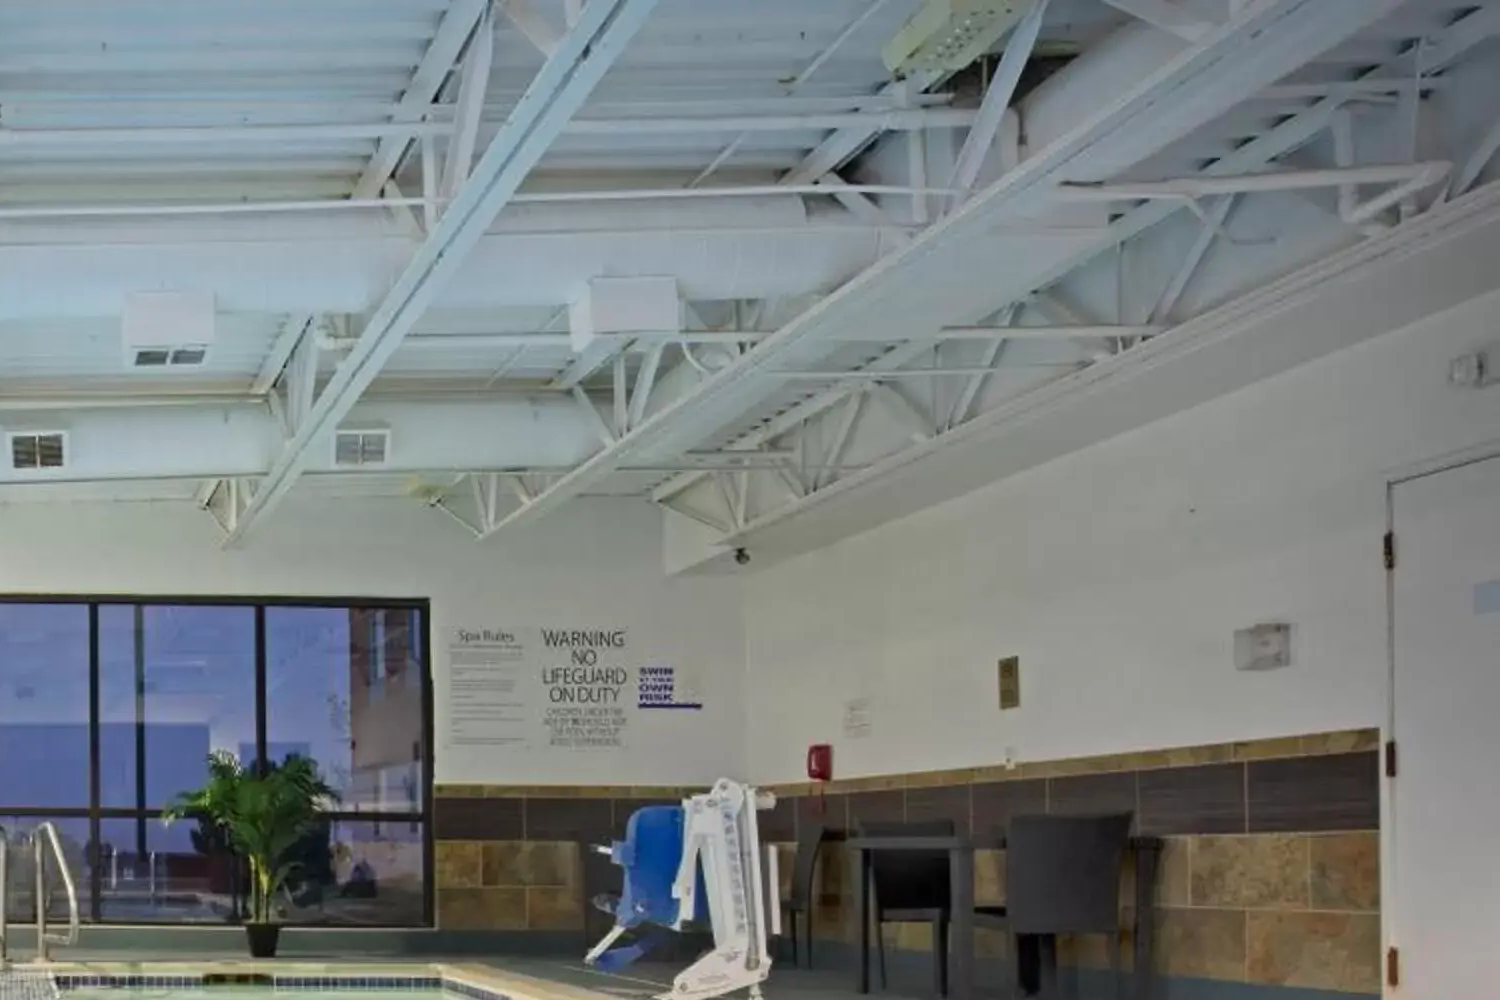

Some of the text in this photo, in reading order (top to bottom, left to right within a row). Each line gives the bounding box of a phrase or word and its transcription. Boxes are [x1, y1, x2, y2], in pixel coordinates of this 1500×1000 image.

[542, 630, 626, 647] WARNING
[571, 649, 597, 666] NO
[542, 667, 627, 685] LIFEGUARD
[549, 686, 621, 703] ON DUTY
[639, 684, 674, 692] OWN
